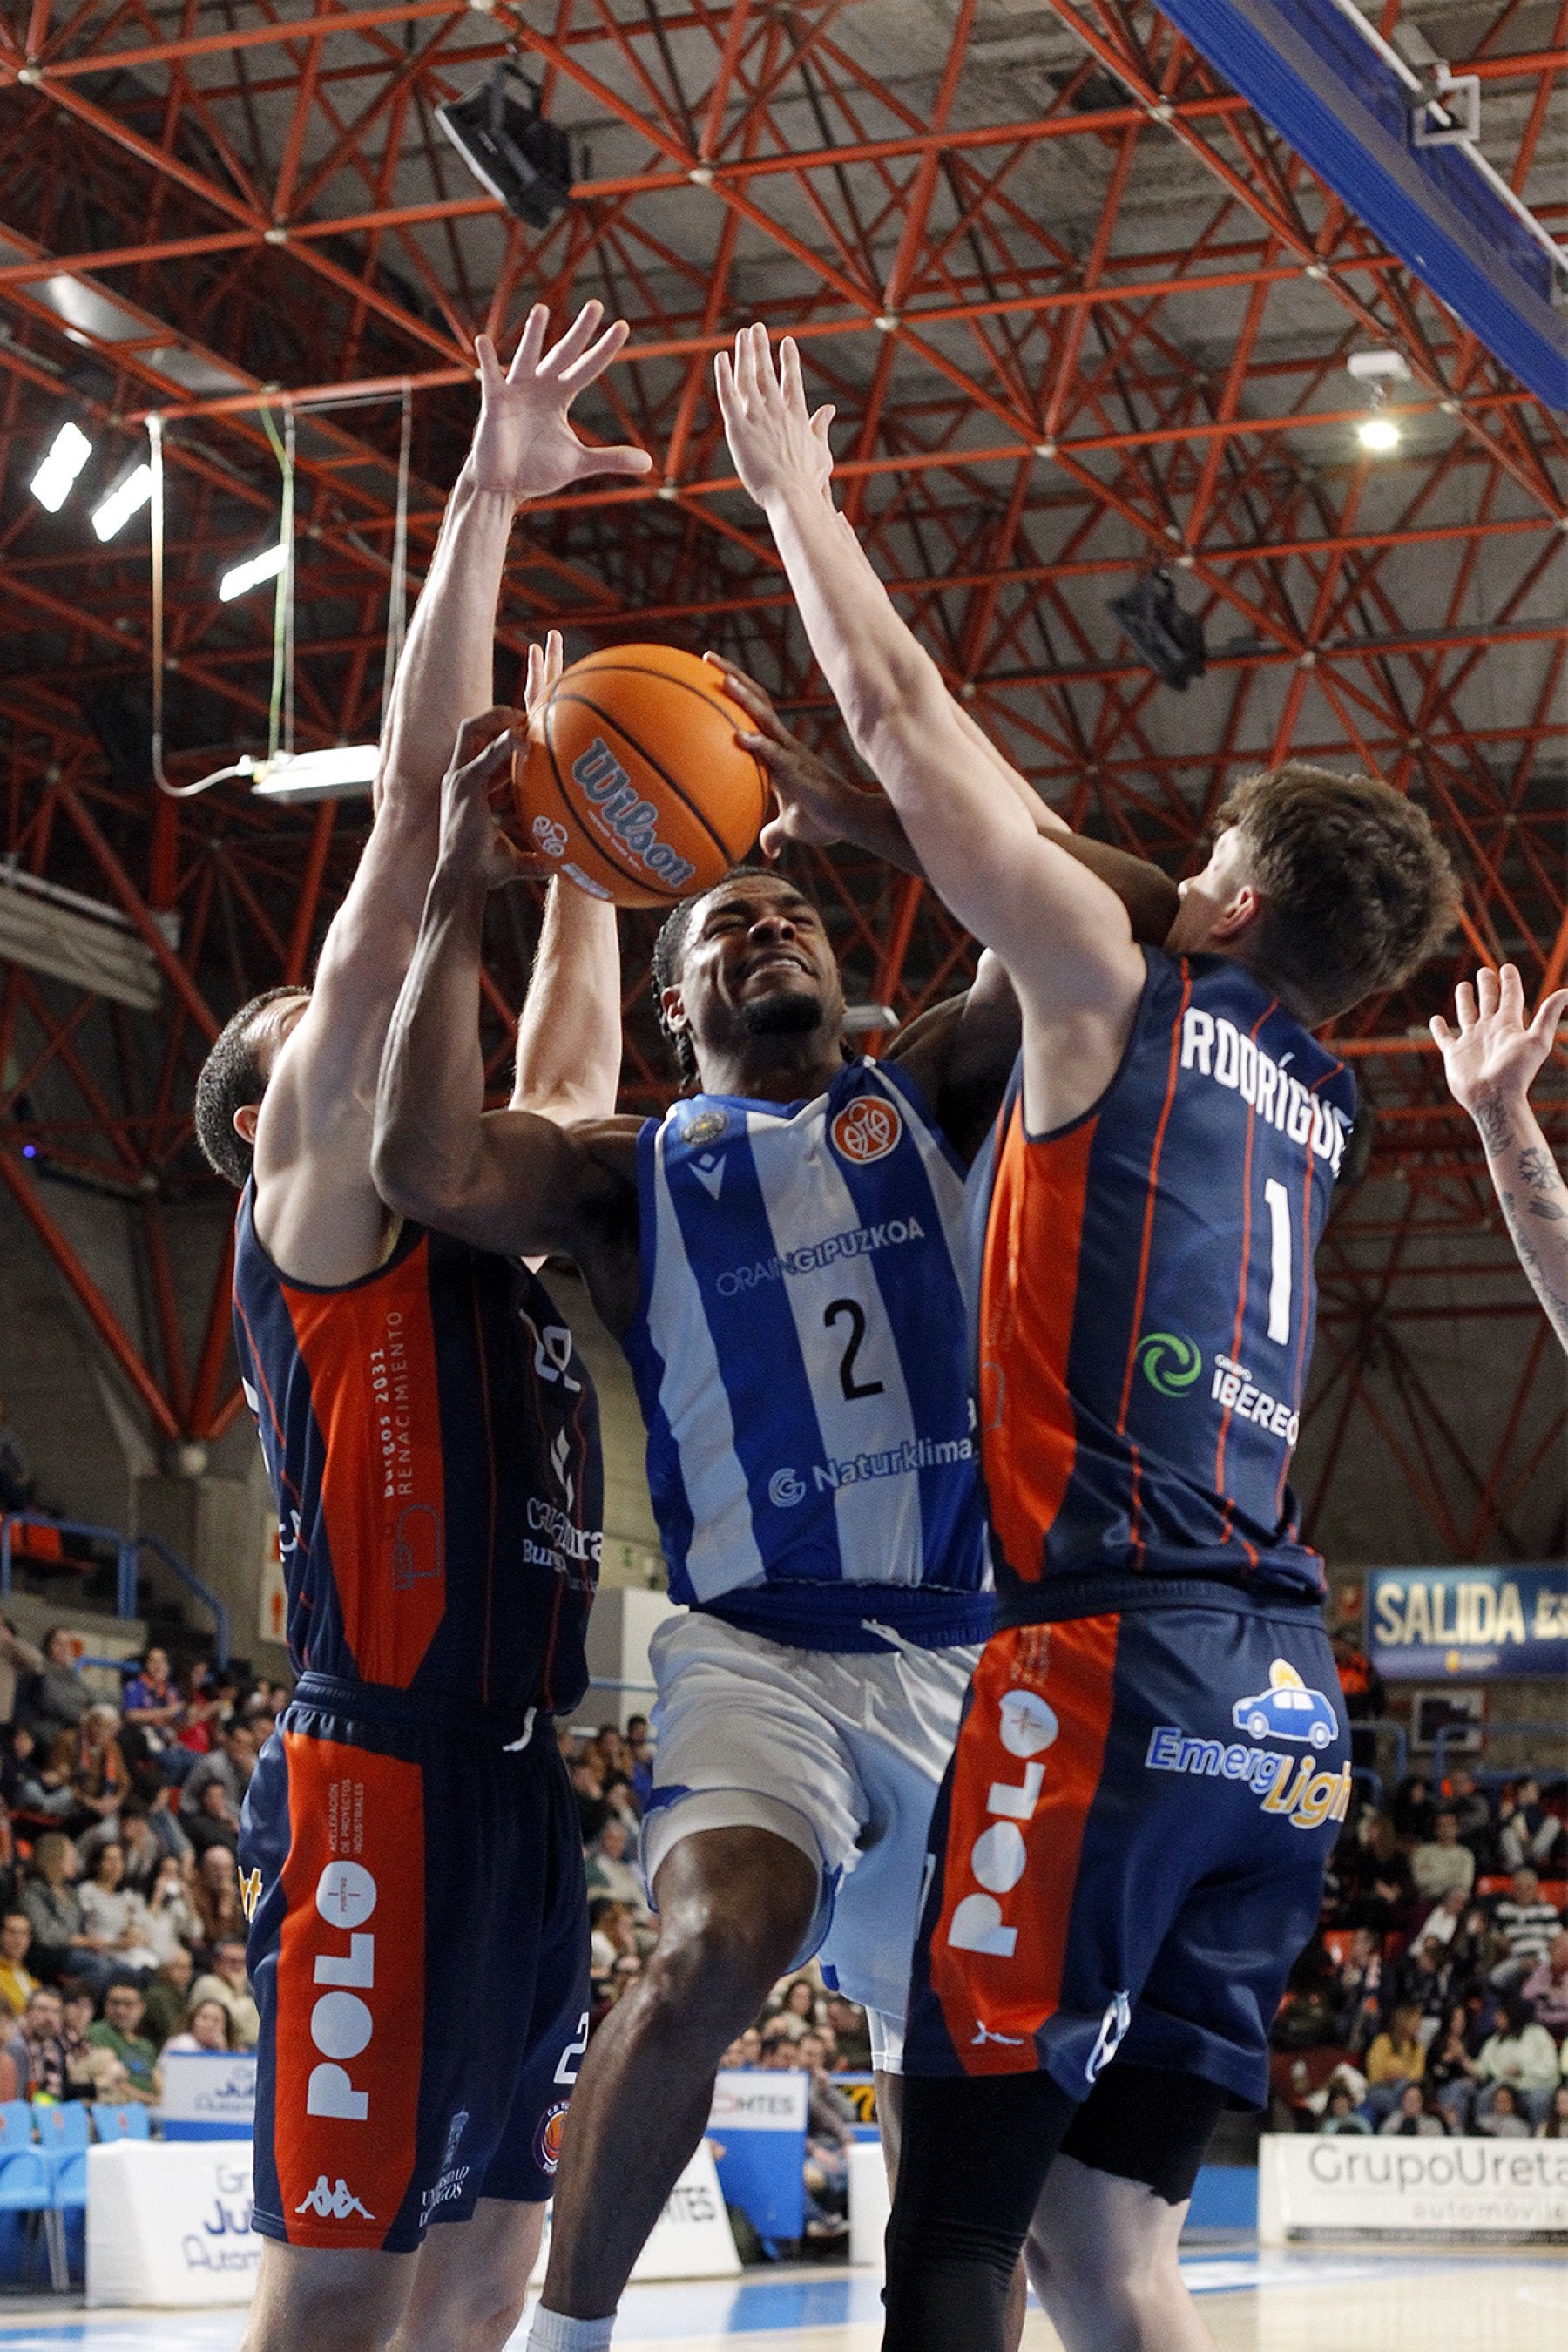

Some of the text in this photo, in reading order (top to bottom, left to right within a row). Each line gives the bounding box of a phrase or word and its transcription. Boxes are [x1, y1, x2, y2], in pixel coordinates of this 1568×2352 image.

[572, 736, 696, 887] Wilson
[1264, 1178, 1291, 1345] 1
[370, 1348, 389, 1402] 2031
[387, 1311, 414, 1496] RENACIMIENTO
[824, 1299, 884, 1401] 2
[813, 1436, 973, 1492] Naturklima
[1374, 1583, 1526, 1645] SALIDA
[948, 1690, 1058, 1957] POLO
[307, 1860, 377, 2120] POLO
